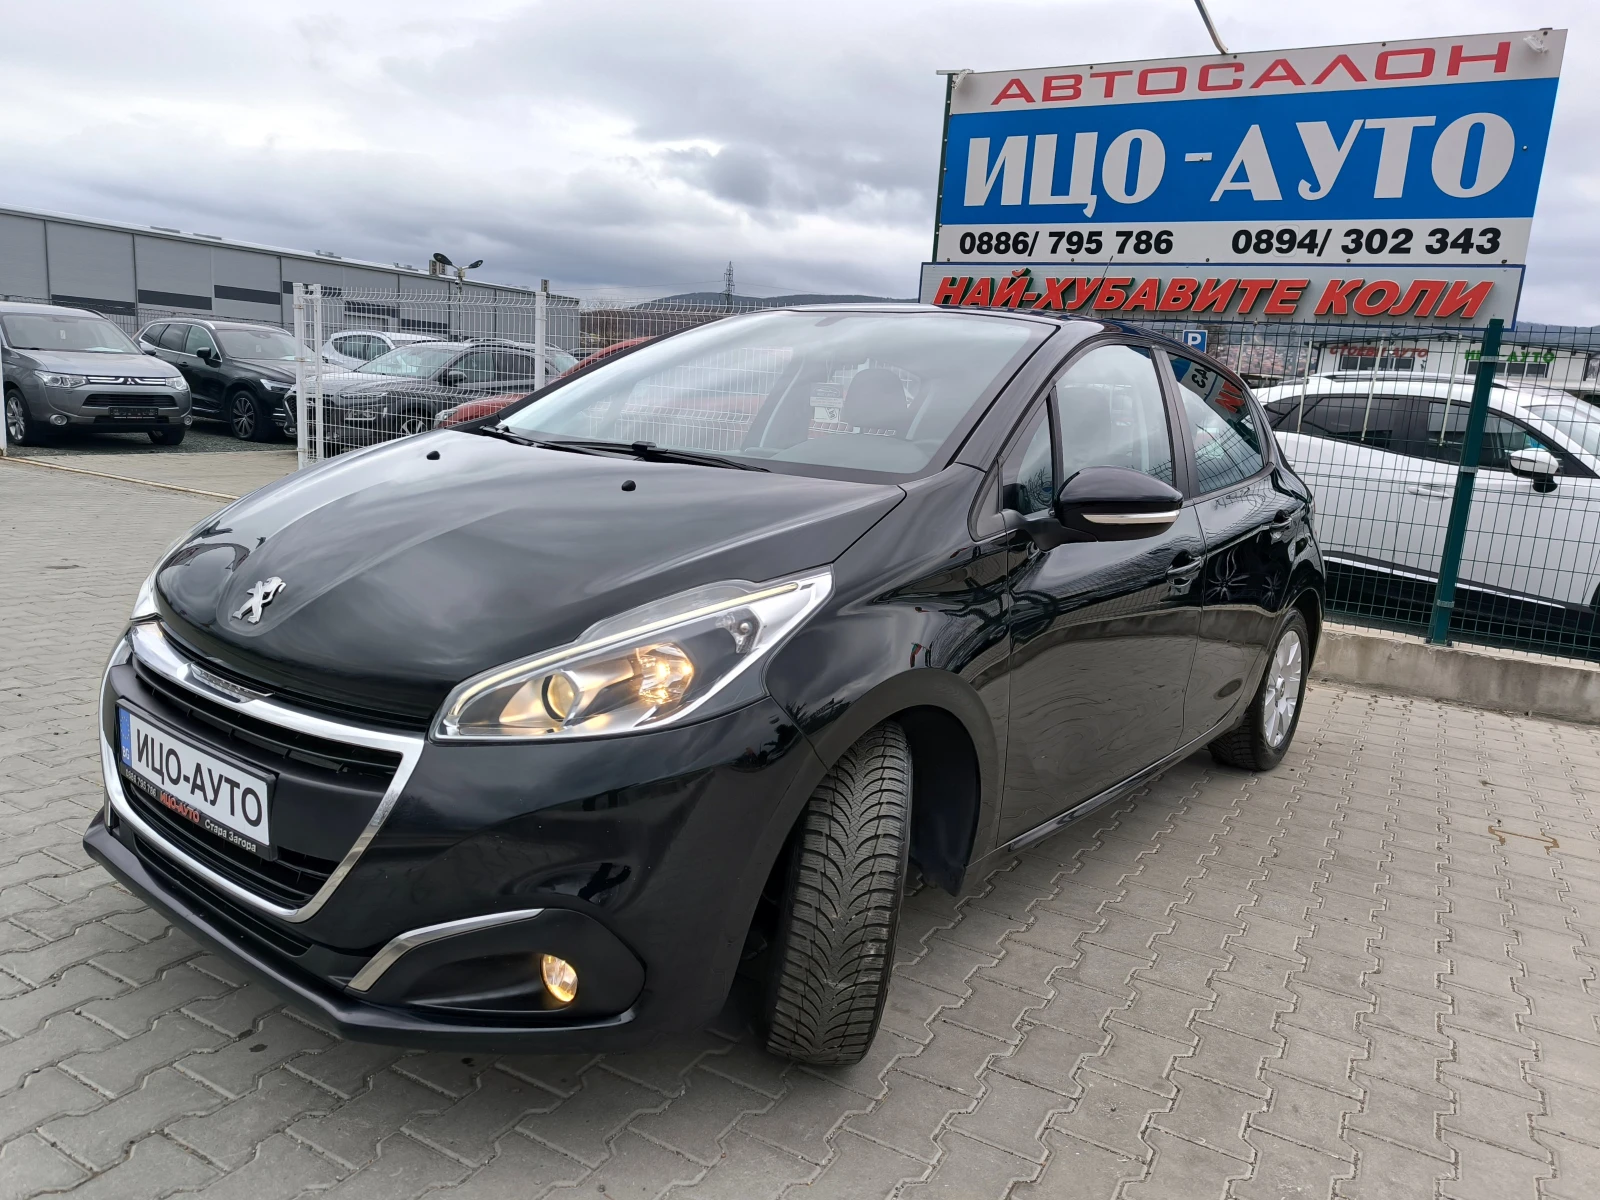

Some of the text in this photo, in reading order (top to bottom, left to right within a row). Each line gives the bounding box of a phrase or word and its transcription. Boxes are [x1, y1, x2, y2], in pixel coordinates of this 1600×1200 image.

[990, 41, 1512, 106] АВТОСАЛОН
[959, 230, 1174, 257] 0886/ 795 786
[1231, 227, 1501, 257] 0894/ 302 343
[933, 266, 1496, 319] НАЙ-ХУБАВИТЕ КОЛИ
[1187, 333, 1202, 347] P
[137, 728, 263, 828] ИЦО-АУТО
[160, 789, 201, 824] ИЦО-АУТО
[204, 818, 257, 853] Стара Загора
